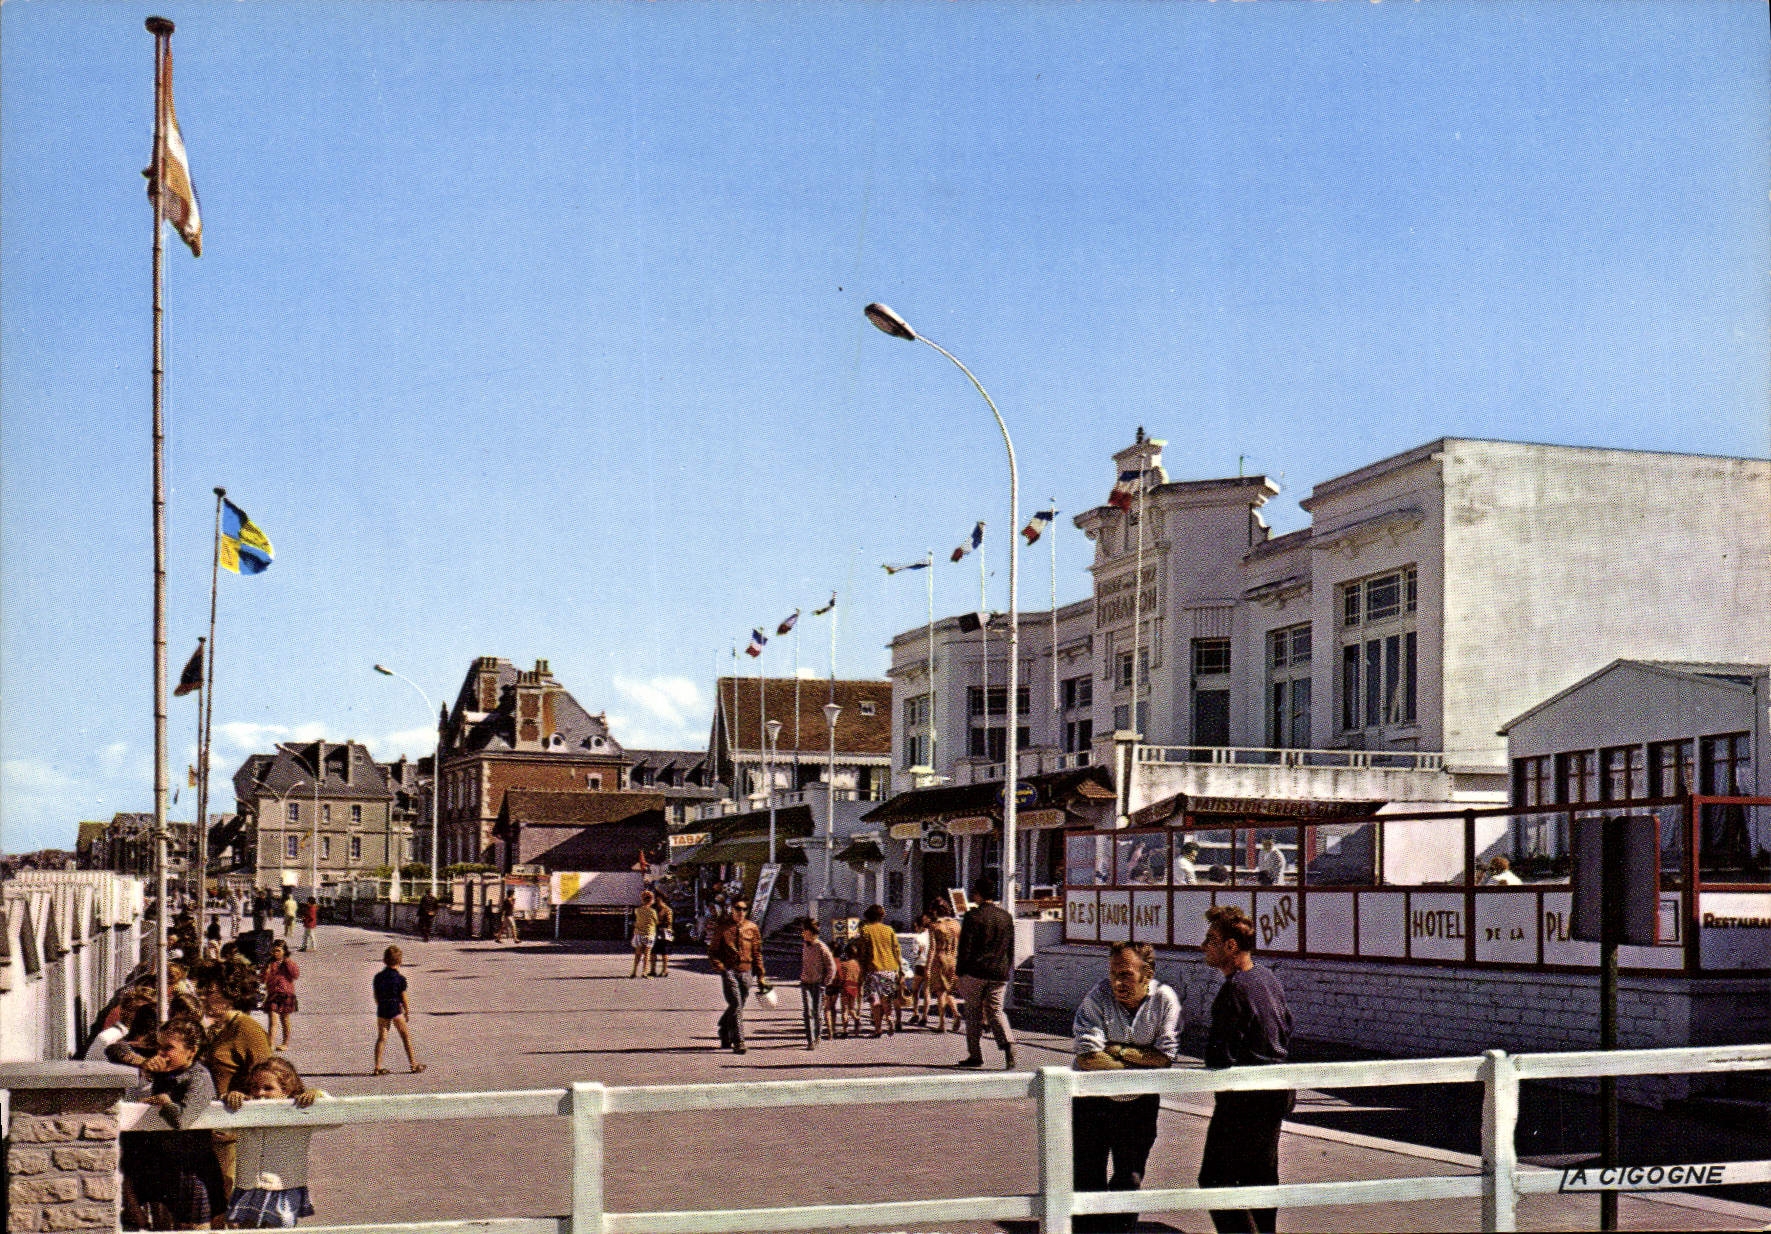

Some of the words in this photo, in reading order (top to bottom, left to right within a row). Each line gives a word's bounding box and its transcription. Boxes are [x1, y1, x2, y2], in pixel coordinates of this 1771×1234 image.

[1068, 902, 1163, 927] RESTAURANT
[1258, 894, 1297, 945] BAR
[1412, 909, 1465, 939] HOTEL
[1510, 926, 1525, 941] LA
[1545, 910, 1571, 942] PL
